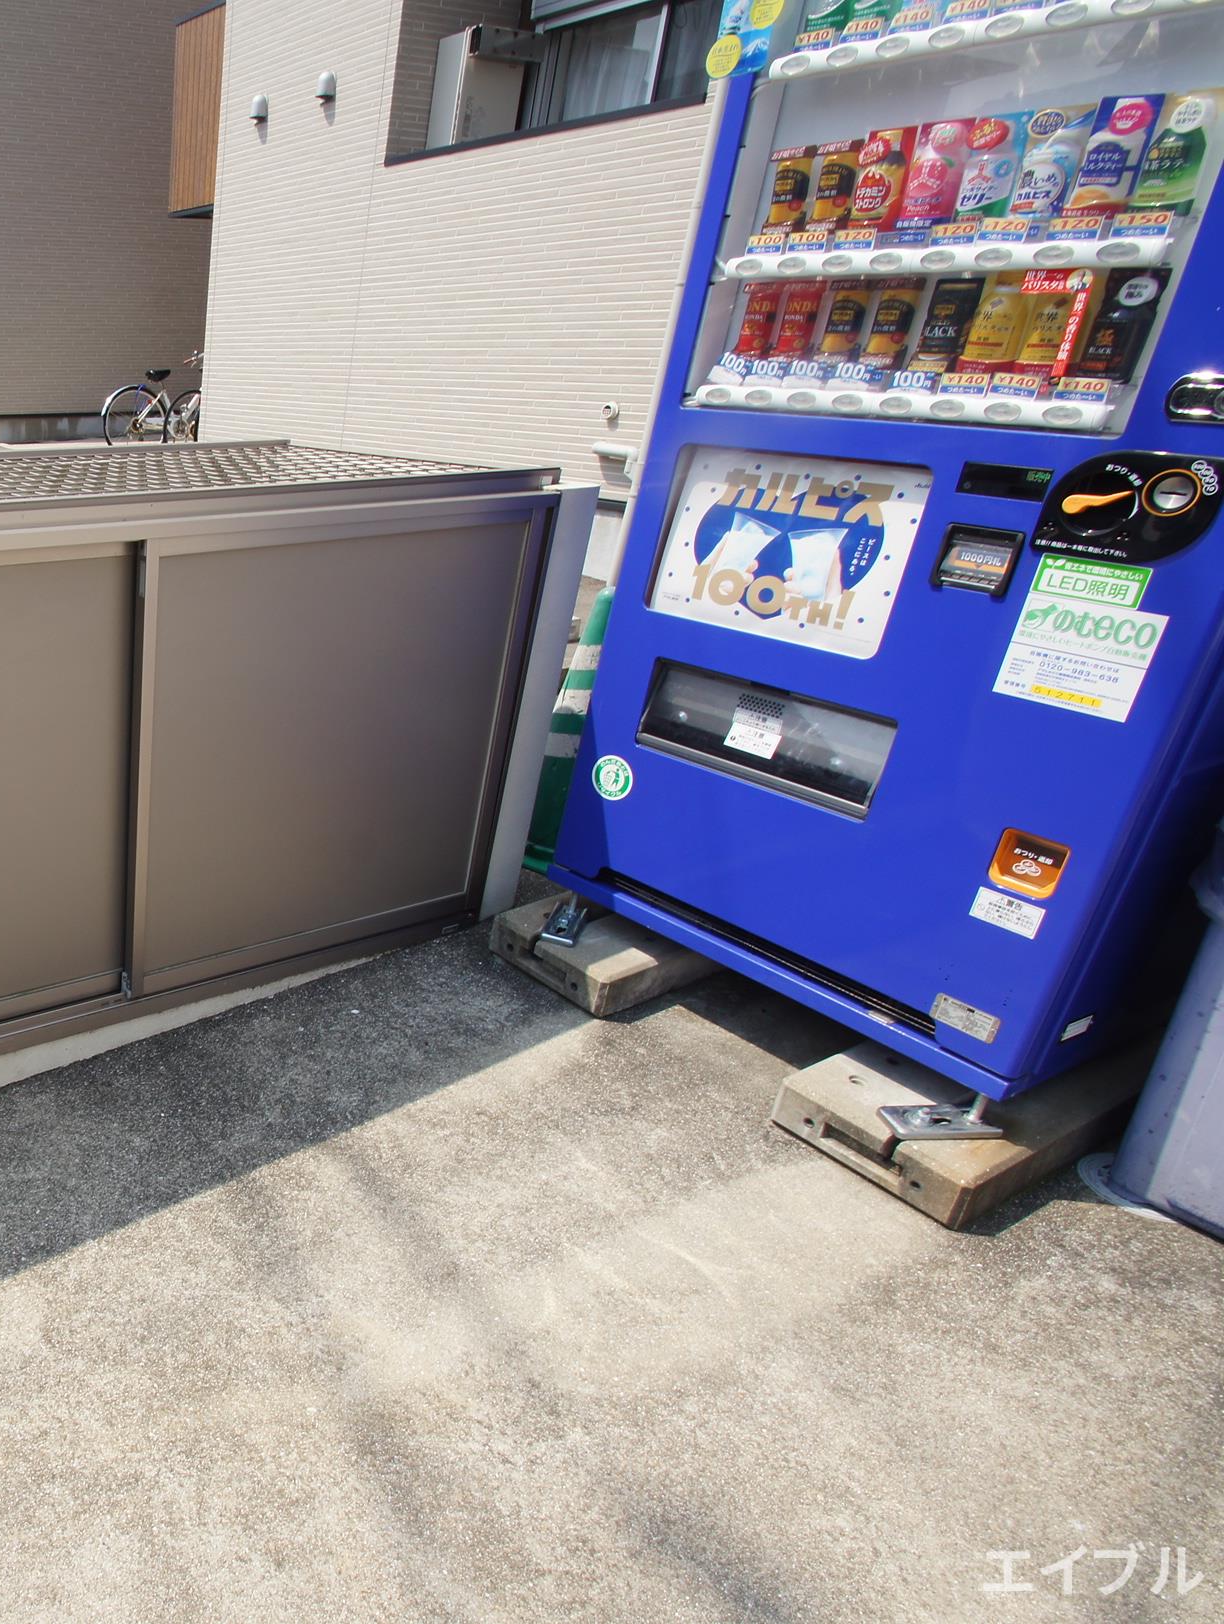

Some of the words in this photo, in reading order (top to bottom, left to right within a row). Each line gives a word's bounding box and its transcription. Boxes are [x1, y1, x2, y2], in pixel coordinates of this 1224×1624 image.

[1088, 151, 1122, 162] ロイヤル
[1052, 219, 1099, 230] ¥120
[1117, 213, 1169, 226] ¥150
[984, 220, 1027, 231] ¥120
[1088, 346, 1112, 354] BLACK
[948, 374, 985, 385] ¥140
[999, 375, 1036, 387] ¥140
[1063, 381, 1105, 391] ¥140
[717, 468, 895, 528] カルピス
[1046, 573, 1130, 600] LED照明
[691, 563, 856, 631] 100TH!
